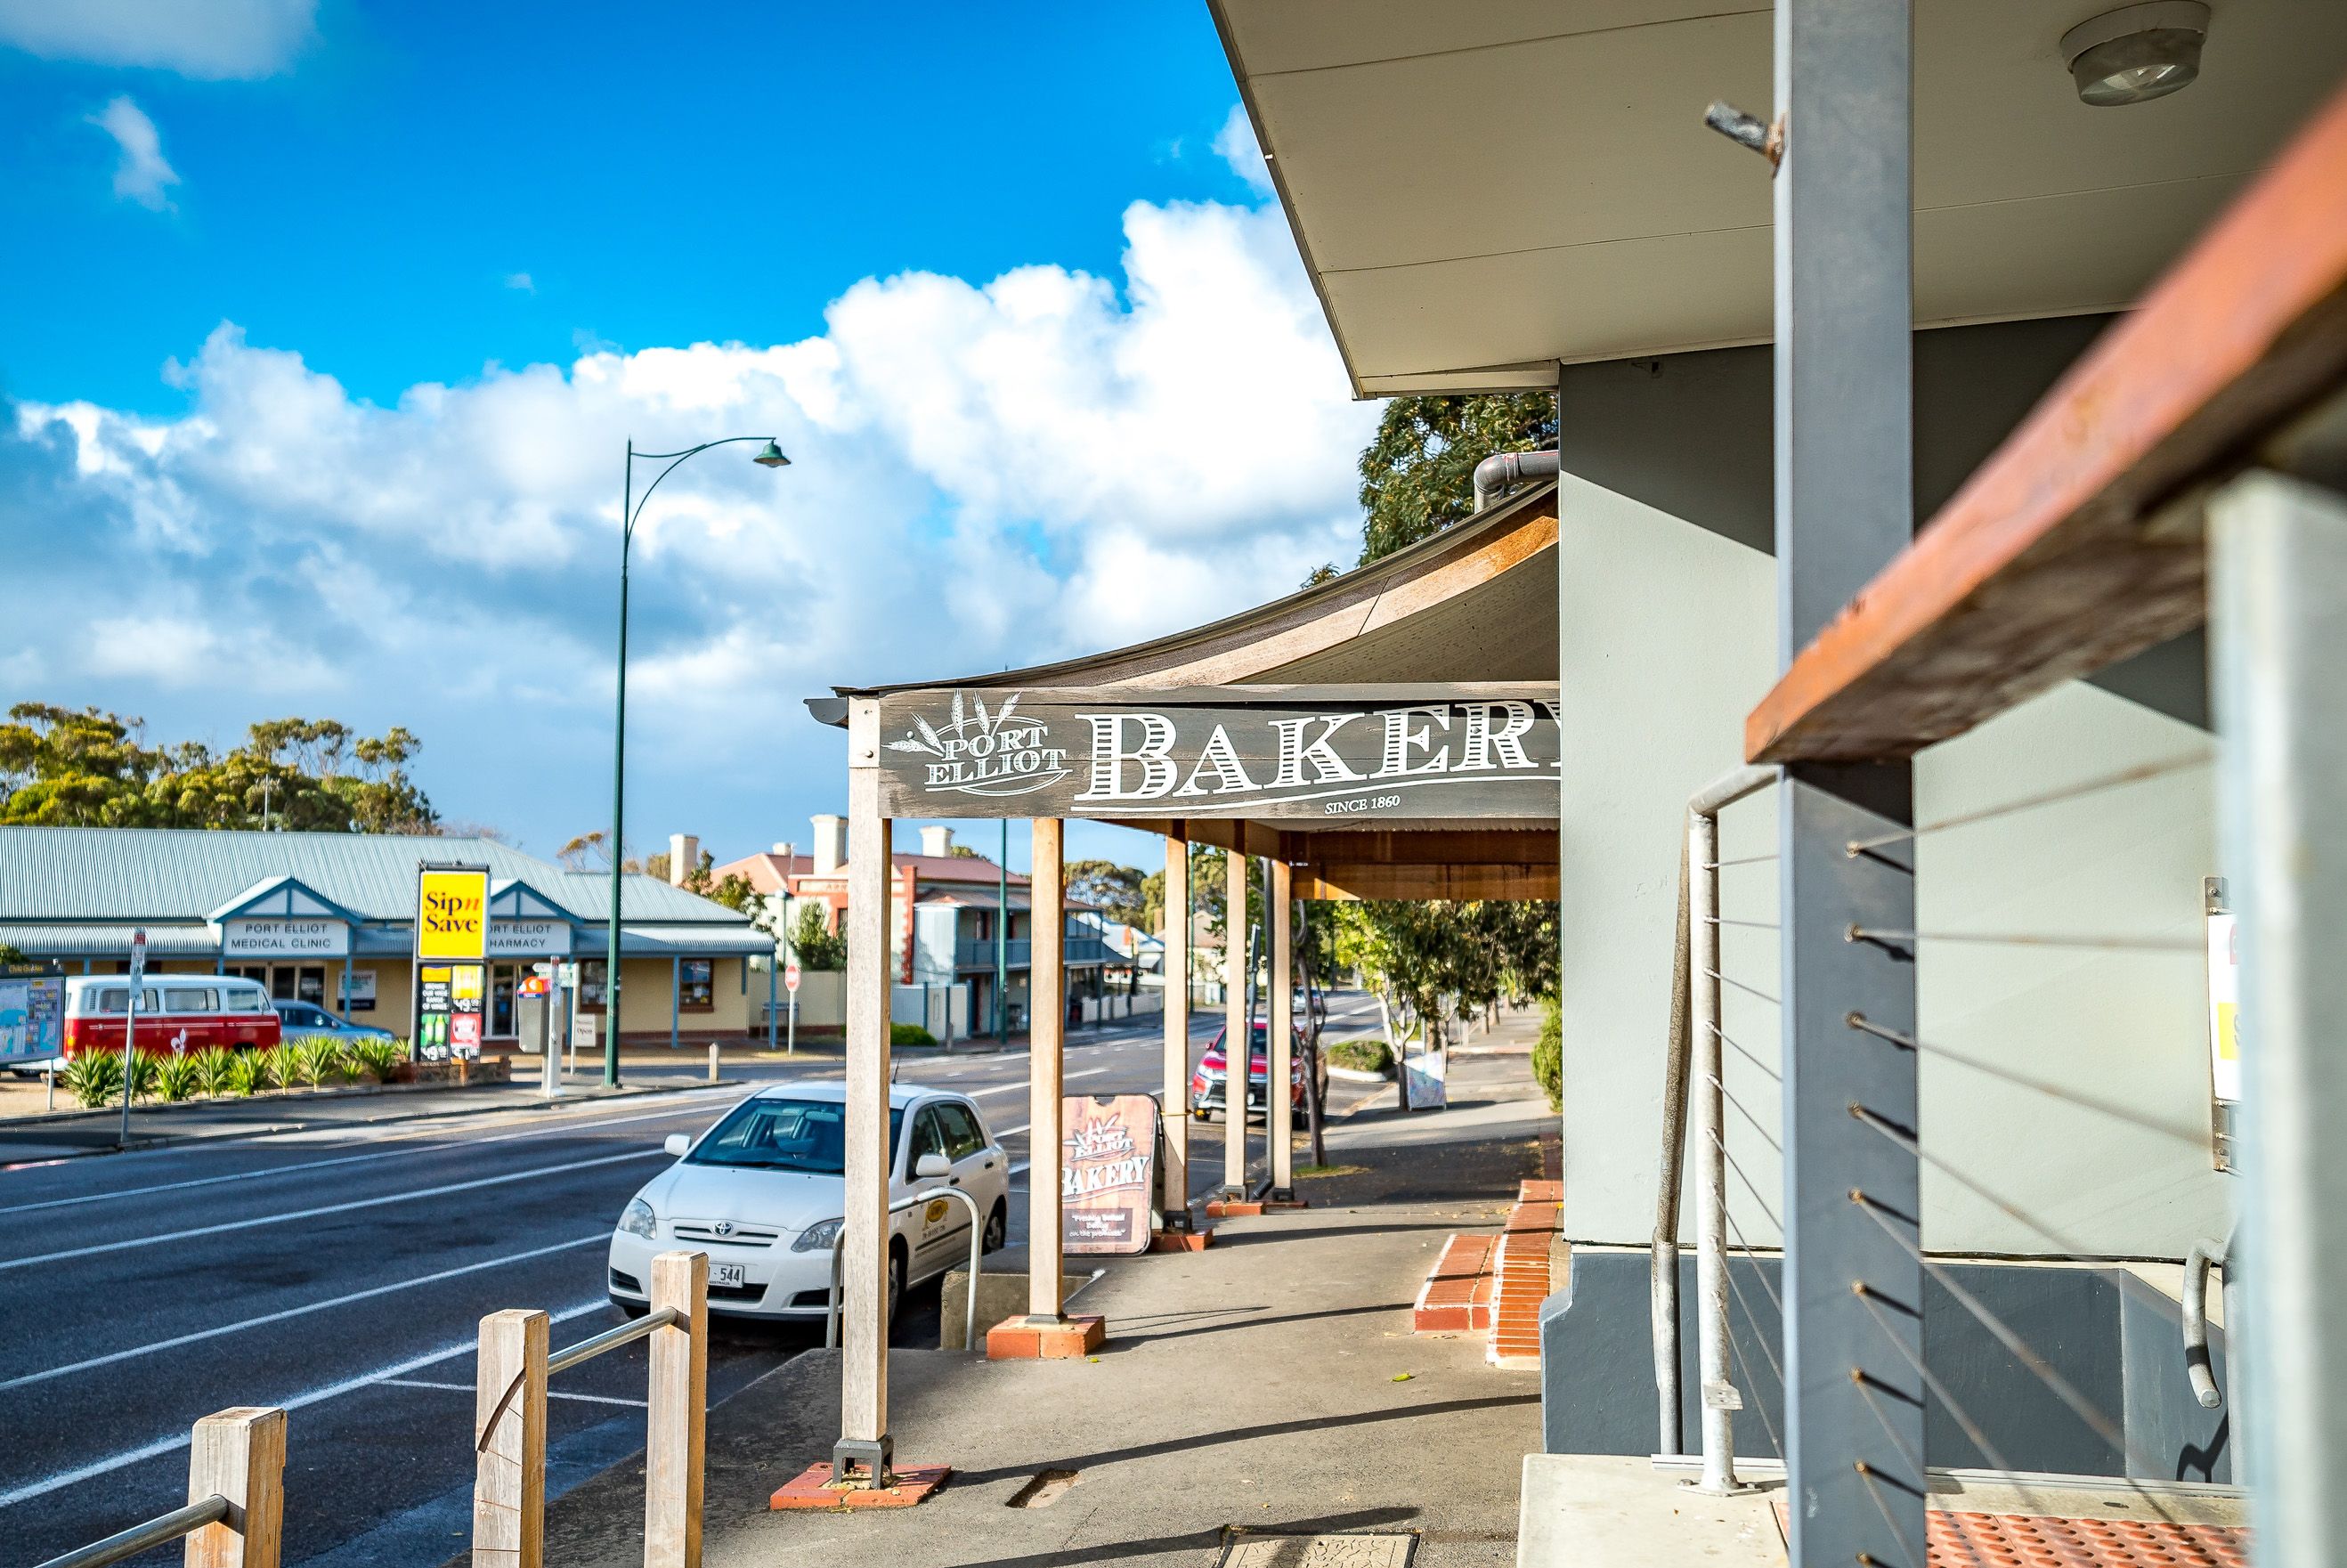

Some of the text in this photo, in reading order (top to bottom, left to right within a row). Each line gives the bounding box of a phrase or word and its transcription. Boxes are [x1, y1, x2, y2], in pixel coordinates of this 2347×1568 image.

[941, 726, 1049, 761] PORT
[924, 748, 1067, 784] ELLIOT
[1324, 795, 1401, 815] SINCE 1860
[245, 923, 328, 934] PORT ELLIOT
[425, 914, 479, 933] Save
[513, 924, 551, 934] ELLIOT
[231, 938, 331, 949] MEDICAL CLINIC
[490, 938, 546, 948] HARMACY
